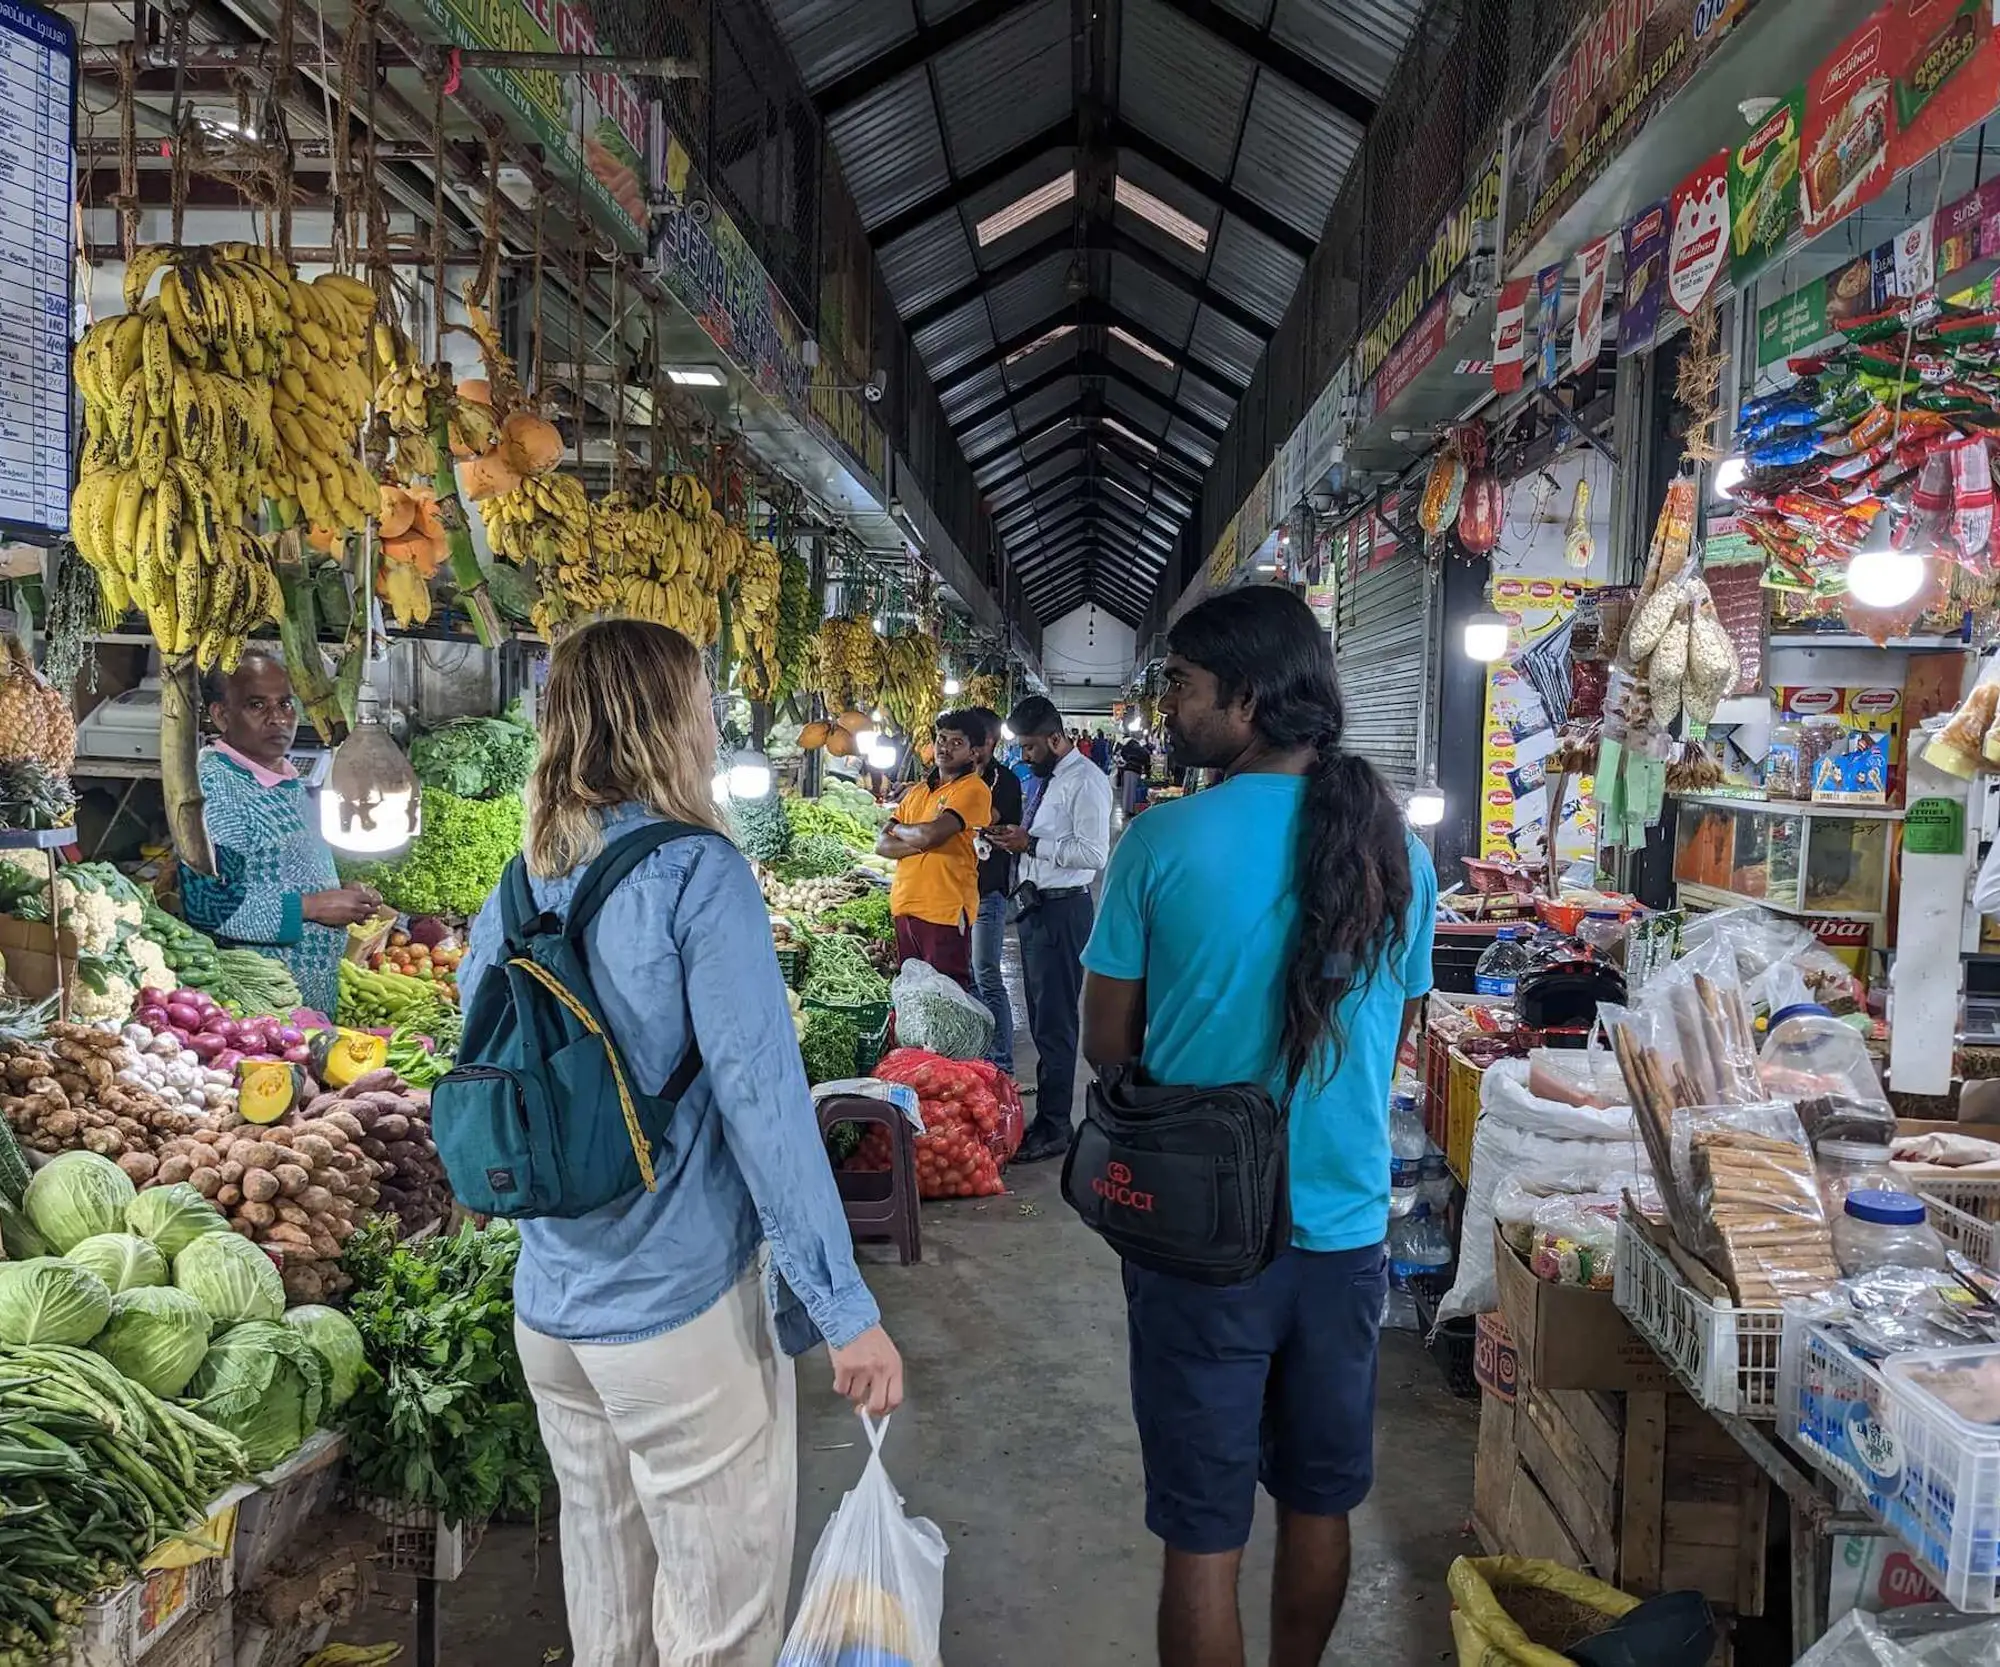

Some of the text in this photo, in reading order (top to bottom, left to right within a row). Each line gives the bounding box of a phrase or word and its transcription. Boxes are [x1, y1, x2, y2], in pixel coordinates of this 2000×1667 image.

[1828, 44, 1875, 88] Maliban
[1600, 78, 1650, 145] NUWARA
[1650, 31, 1686, 90] ELIYA
[1679, 237, 1716, 263] Maliban
[1091, 1178, 1154, 1212] GUCCI
